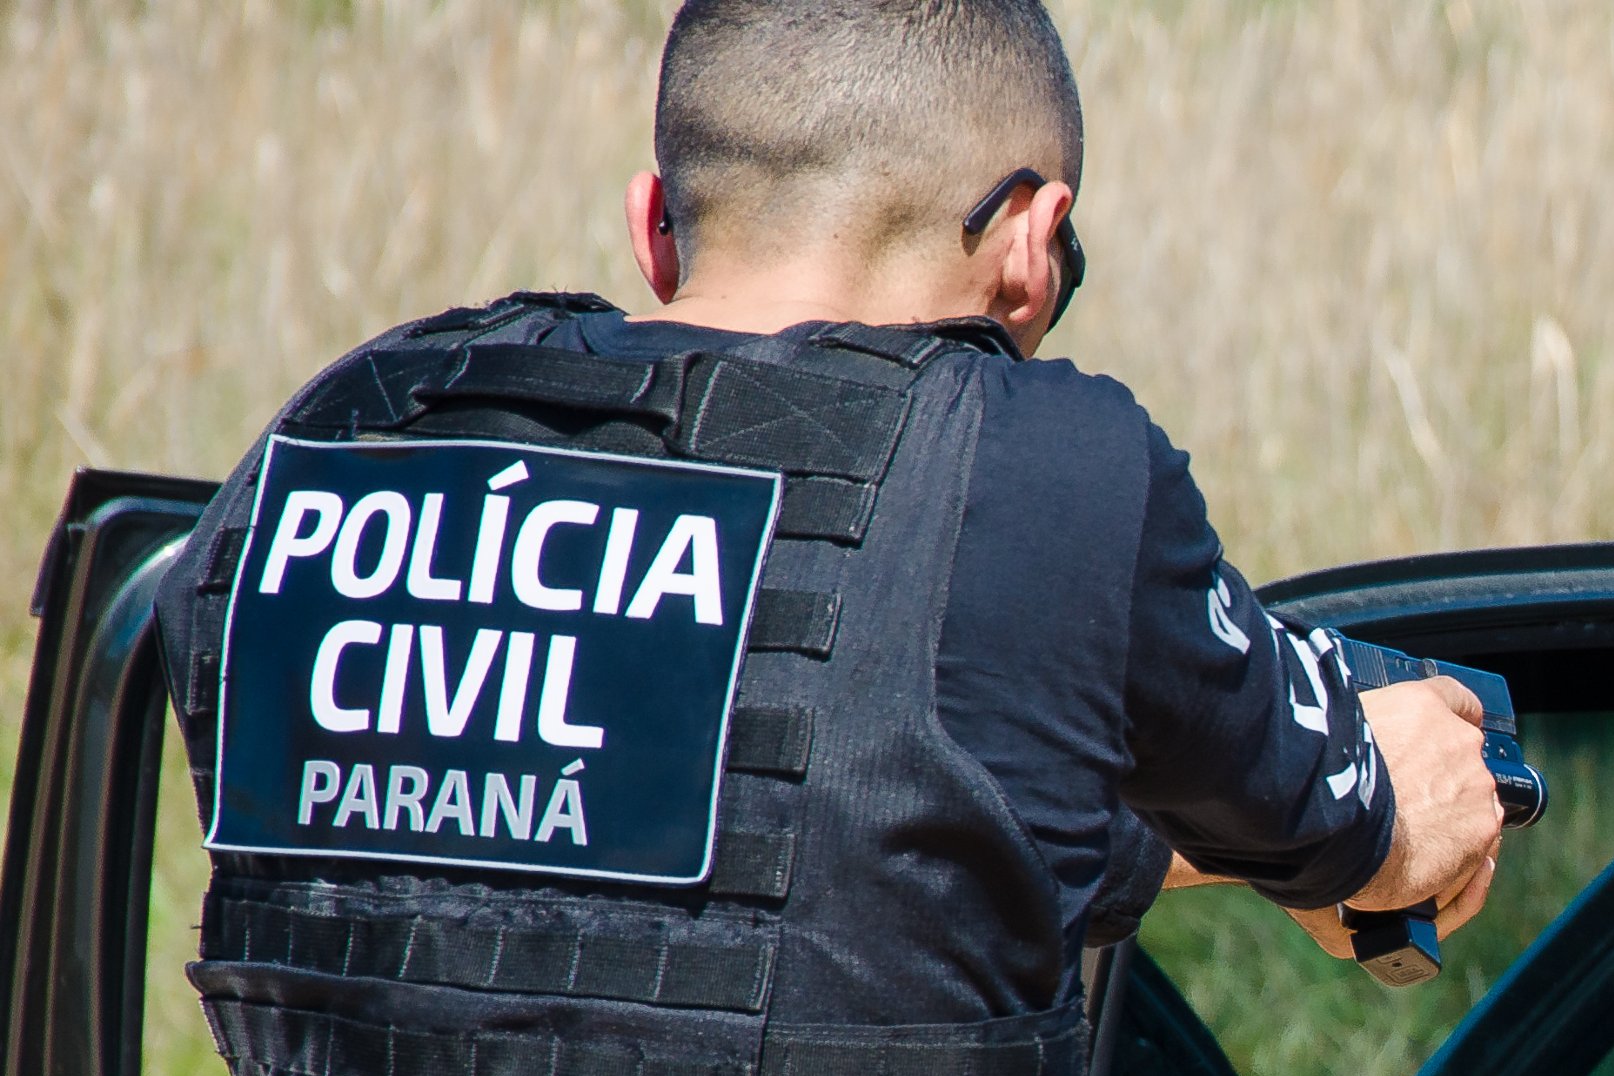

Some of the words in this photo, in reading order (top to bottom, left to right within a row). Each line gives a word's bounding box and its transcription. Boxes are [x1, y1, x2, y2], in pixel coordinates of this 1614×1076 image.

[258, 460, 724, 625] POLÍCIA
[310, 620, 604, 748] CIVIL
[297, 758, 588, 846] PARANÁ
